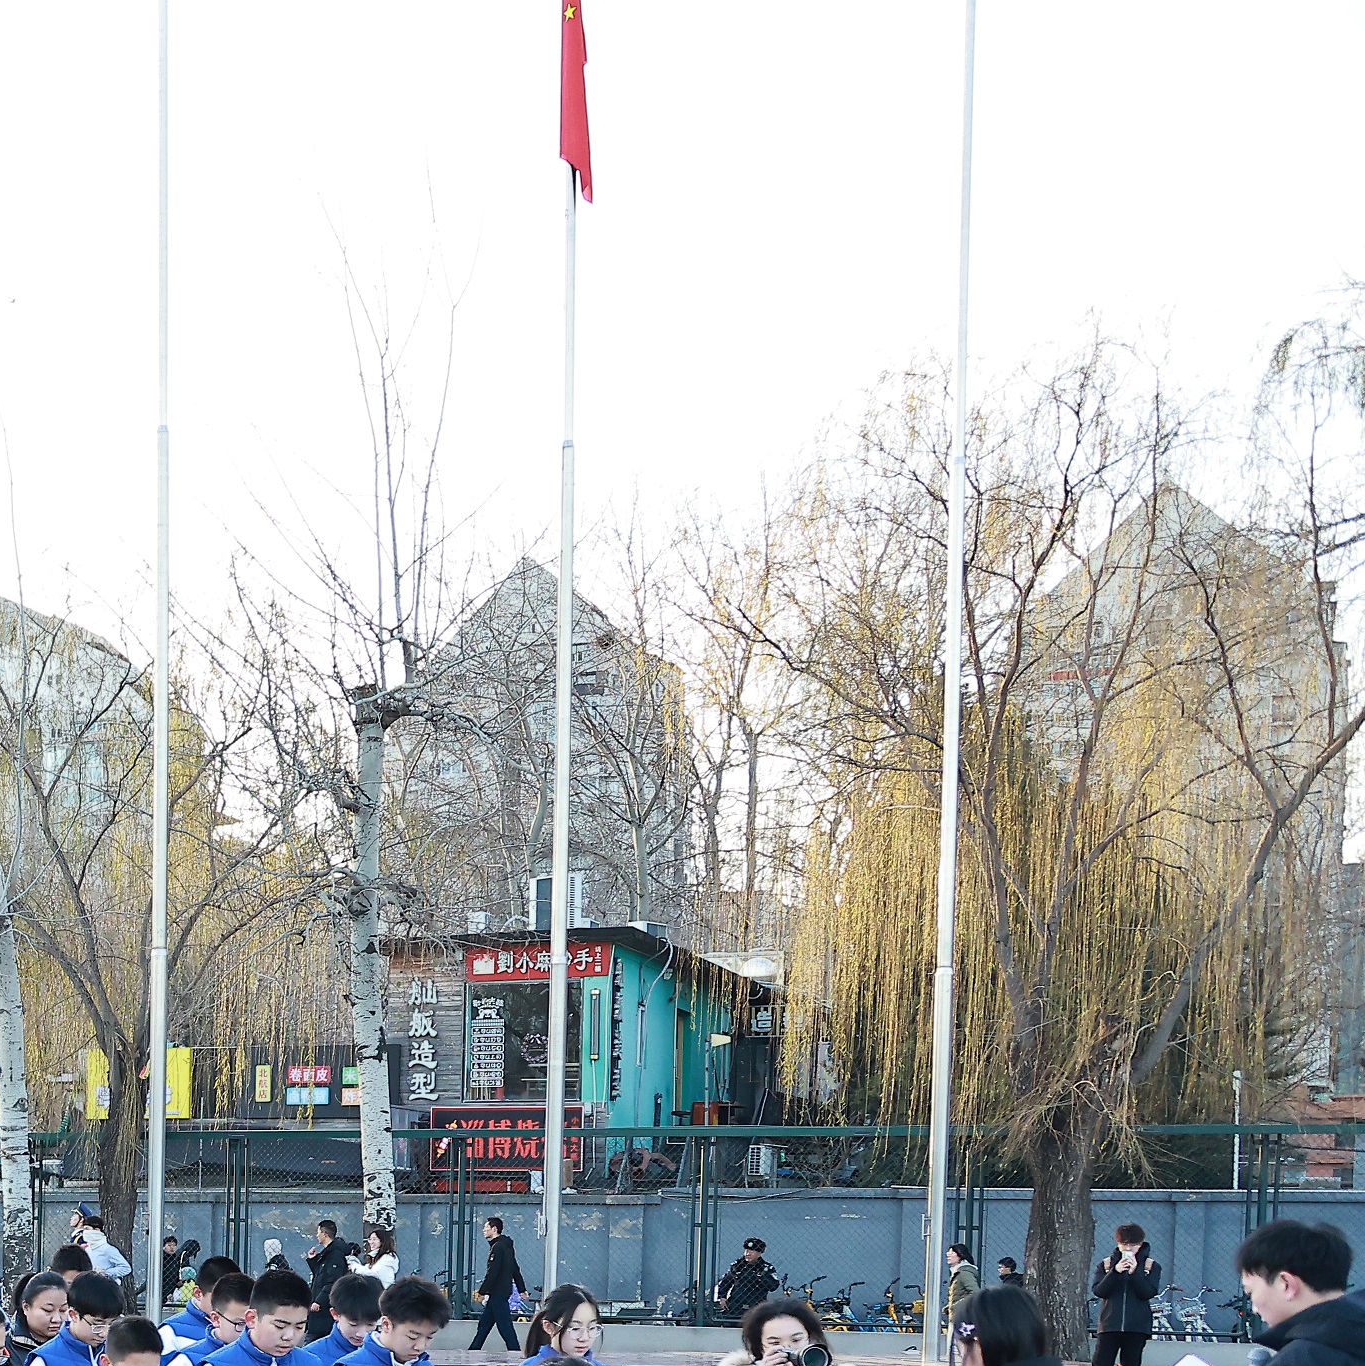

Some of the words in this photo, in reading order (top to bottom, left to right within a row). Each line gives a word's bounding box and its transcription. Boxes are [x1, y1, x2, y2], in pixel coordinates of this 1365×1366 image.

[496, 947, 594, 974] 劉小麻手
[408, 977, 439, 1101] 舢舨造型
